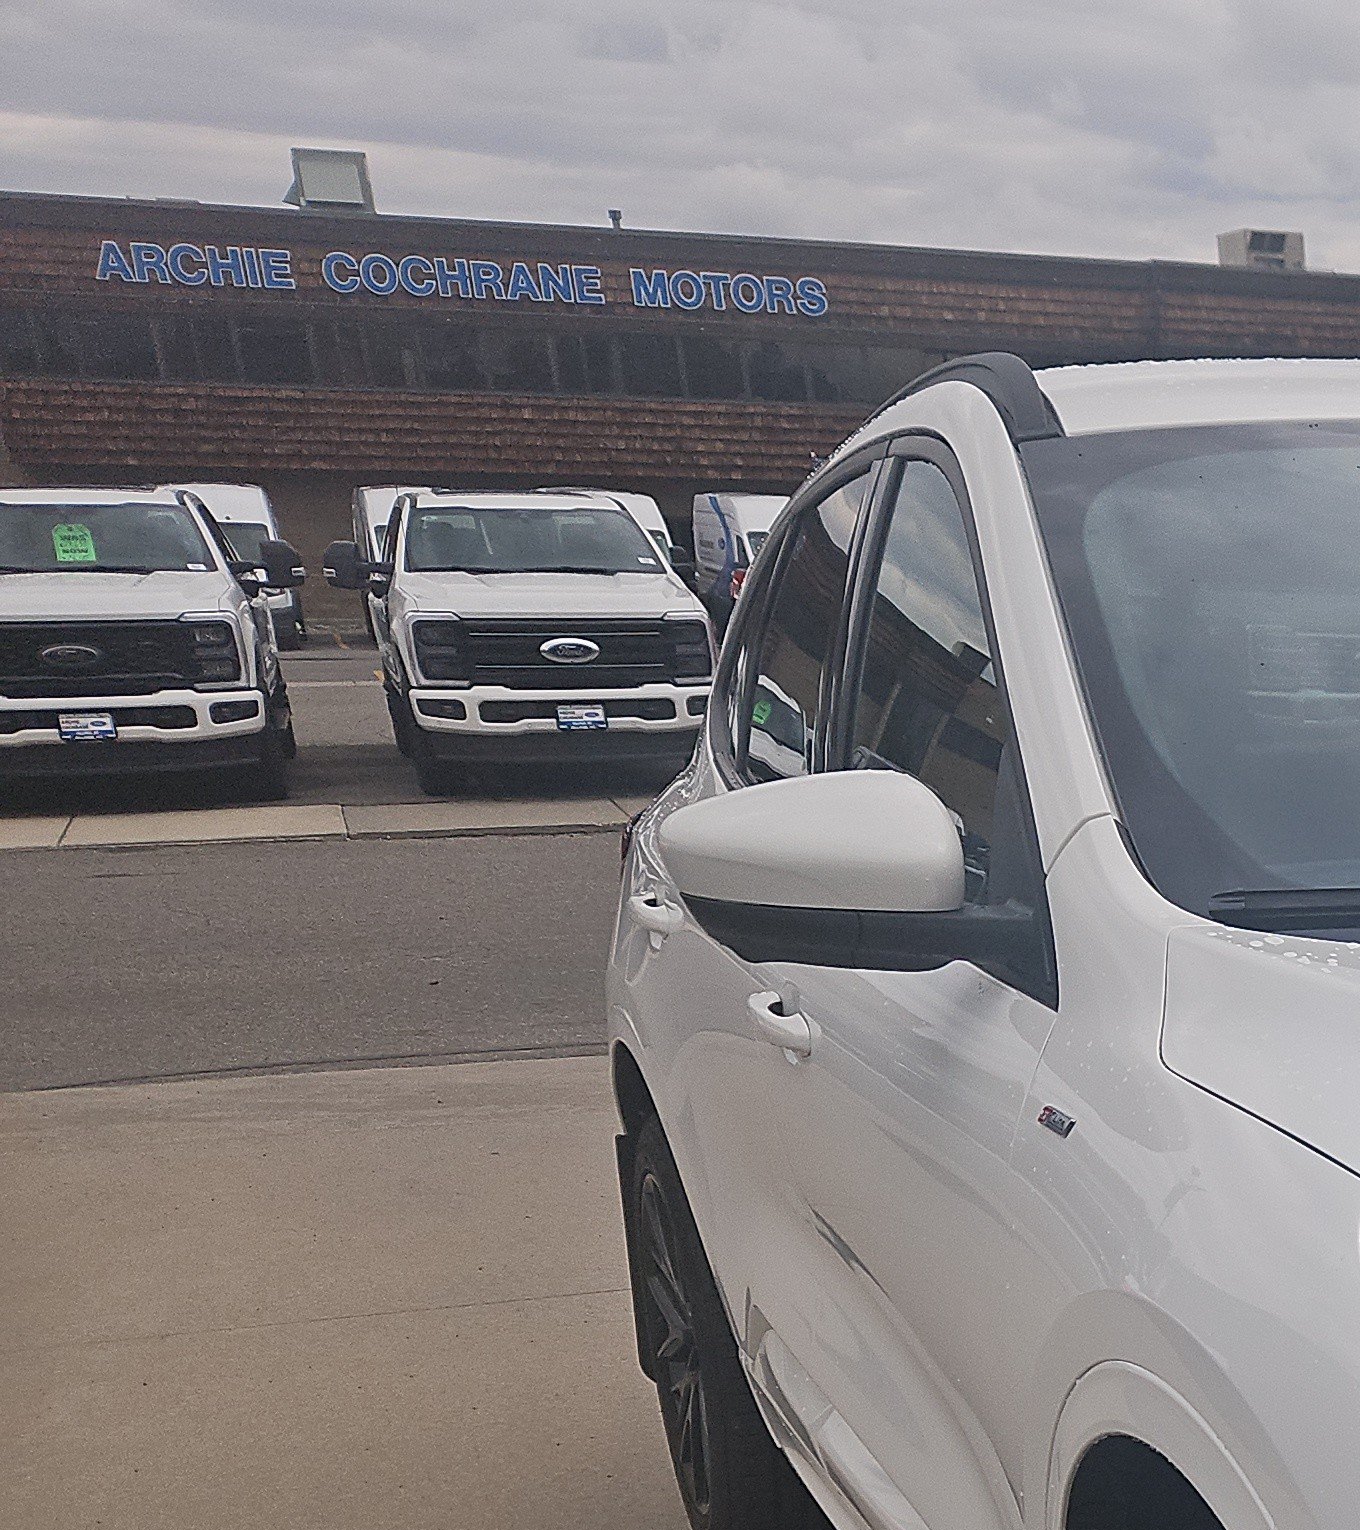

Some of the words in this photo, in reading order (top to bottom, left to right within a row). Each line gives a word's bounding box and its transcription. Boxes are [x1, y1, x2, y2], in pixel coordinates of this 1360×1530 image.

[96, 241, 296, 289] ARCHIE
[321, 251, 605, 305] COCHRANE
[629, 267, 828, 317] MOTORS
